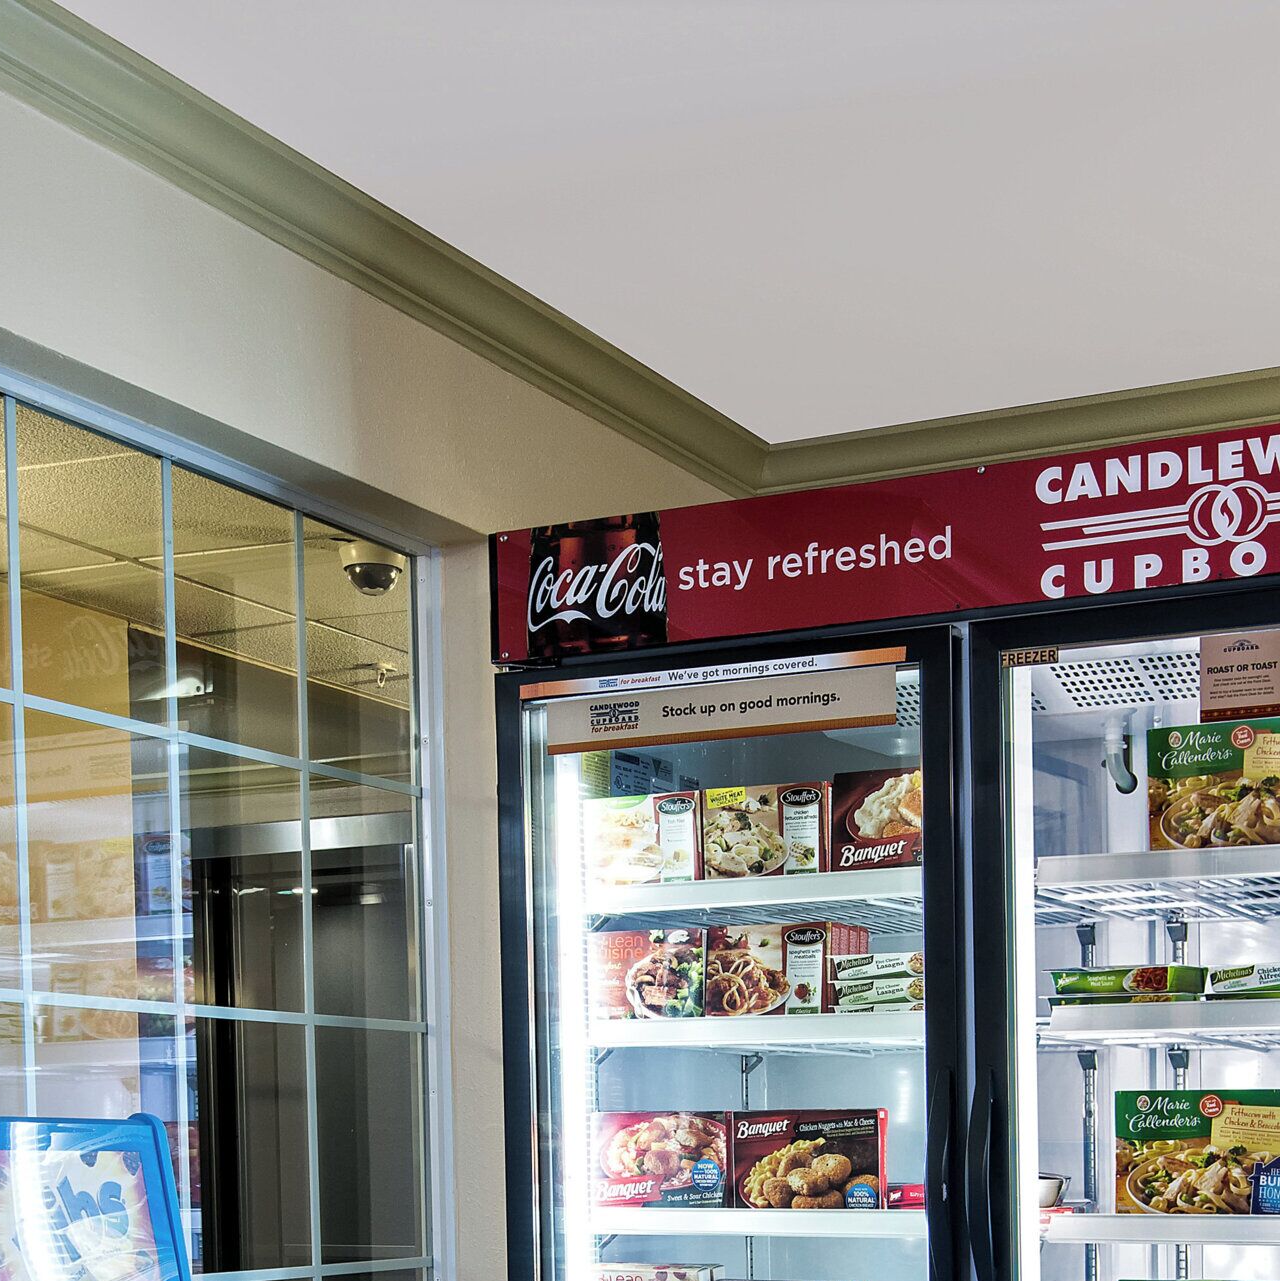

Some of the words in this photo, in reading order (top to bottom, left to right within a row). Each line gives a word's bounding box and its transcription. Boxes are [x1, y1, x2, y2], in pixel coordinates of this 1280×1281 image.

[678, 555, 753, 591] stay
[767, 526, 953, 580] refreshed
[527, 543, 666, 632] Coca-Cola
[1002, 649, 1057, 666] FREEZER
[668, 671, 699, 682] We've
[702, 669, 720, 680] got
[722, 664, 770, 679] mornings
[773, 658, 817, 672] covered.
[1207, 665, 1234, 675] ROAST
[1236, 664, 1249, 672] OR
[1250, 661, 1278, 671] TOAST
[589, 700, 640, 712] CANDLEWOOD
[662, 703, 696, 718] Stock
[700, 704, 715, 717] up
[719, 702, 735, 712] on
[739, 696, 772, 713] good
[776, 690, 840, 708] mornings.
[589, 715, 641, 726] CUPBOARD
[591, 725, 602, 734] for
[603, 721, 639, 732] breakfast
[1178, 731, 1222, 751] Marie
[1158, 747, 1233, 770] Callender's
[785, 790, 817, 803] Stouffer's
[658, 799, 694, 814] Stouffer's
[839, 839, 908, 867] Banquet
[609, 934, 643, 948] Lean
[790, 930, 821, 942] Stouffer's
[837, 955, 874, 971] Michelina's
[876, 962, 905, 970] Lasagna
[1210, 965, 1254, 986] Michelina's
[837, 981, 874, 997] Michelina's
[876, 987, 905, 996] Lasagna
[1146, 1096, 1190, 1115] Marie
[737, 1119, 791, 1139] Banquet
[1125, 1113, 1200, 1132] Callender's
[597, 1180, 655, 1200] Banquet
